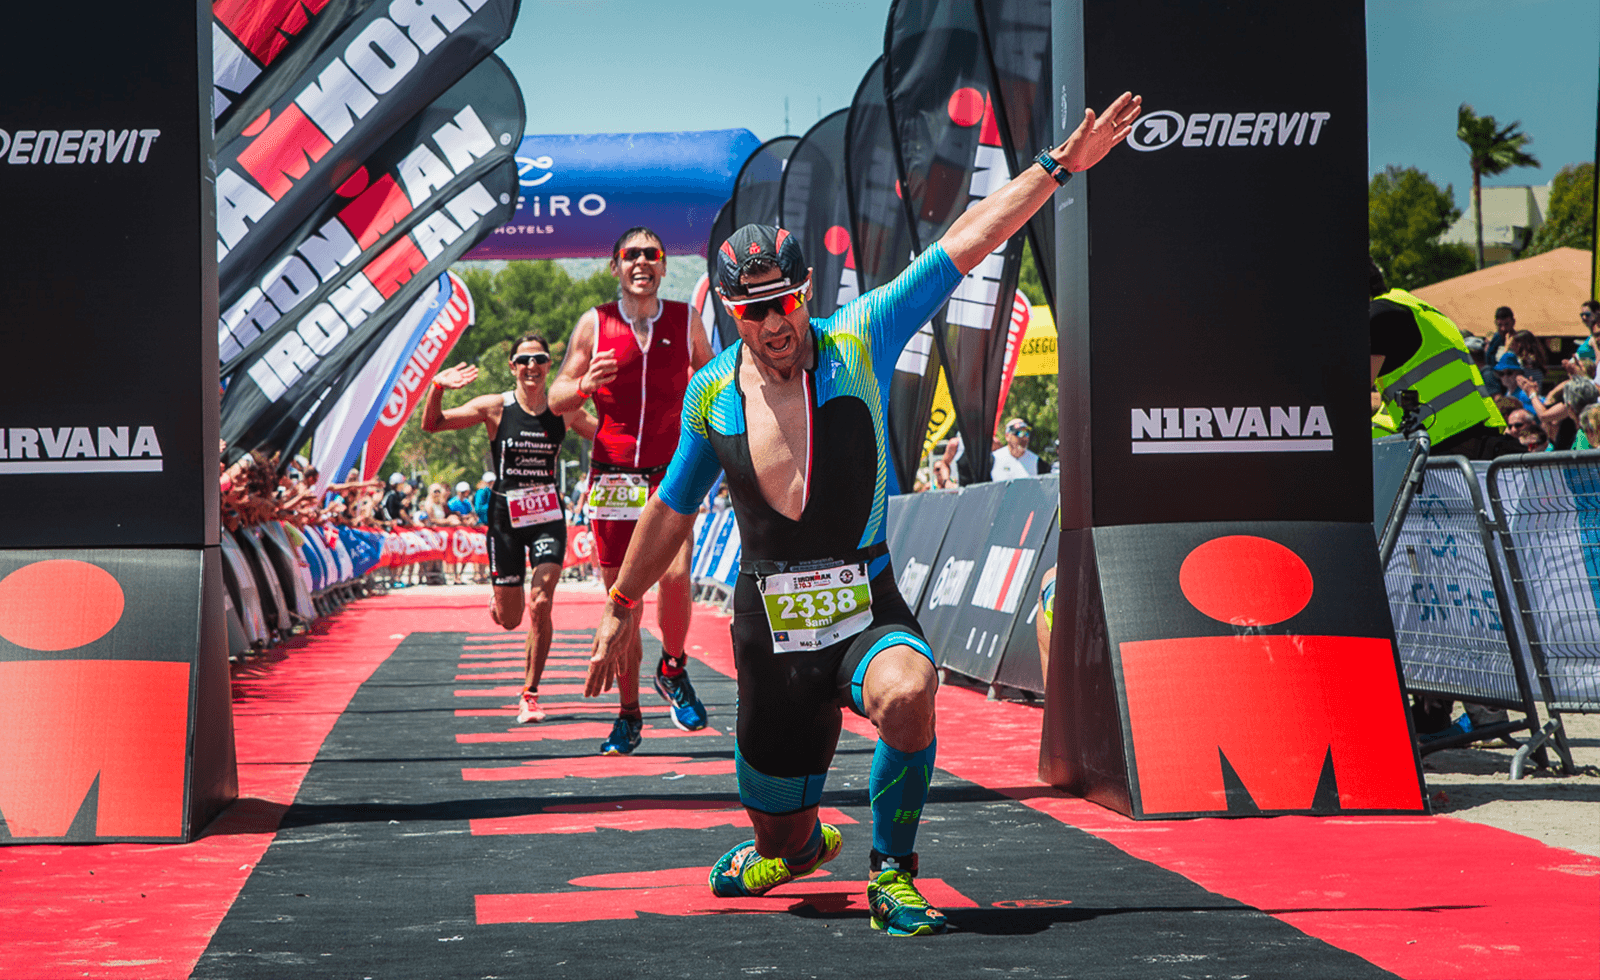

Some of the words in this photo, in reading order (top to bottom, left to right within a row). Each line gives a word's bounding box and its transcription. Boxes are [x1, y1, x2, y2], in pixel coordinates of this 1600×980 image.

[1182, 111, 1331, 147] ENERVIT
[8, 129, 161, 165] ENERVIT
[247, 181, 498, 404] IRONMAN
[506, 468, 549, 477] GOLDWELL
[516, 495, 551, 512] 1011
[594, 486, 639, 502] 2780
[777, 588, 858, 620] 2338
[805, 615, 833, 628] Sami
